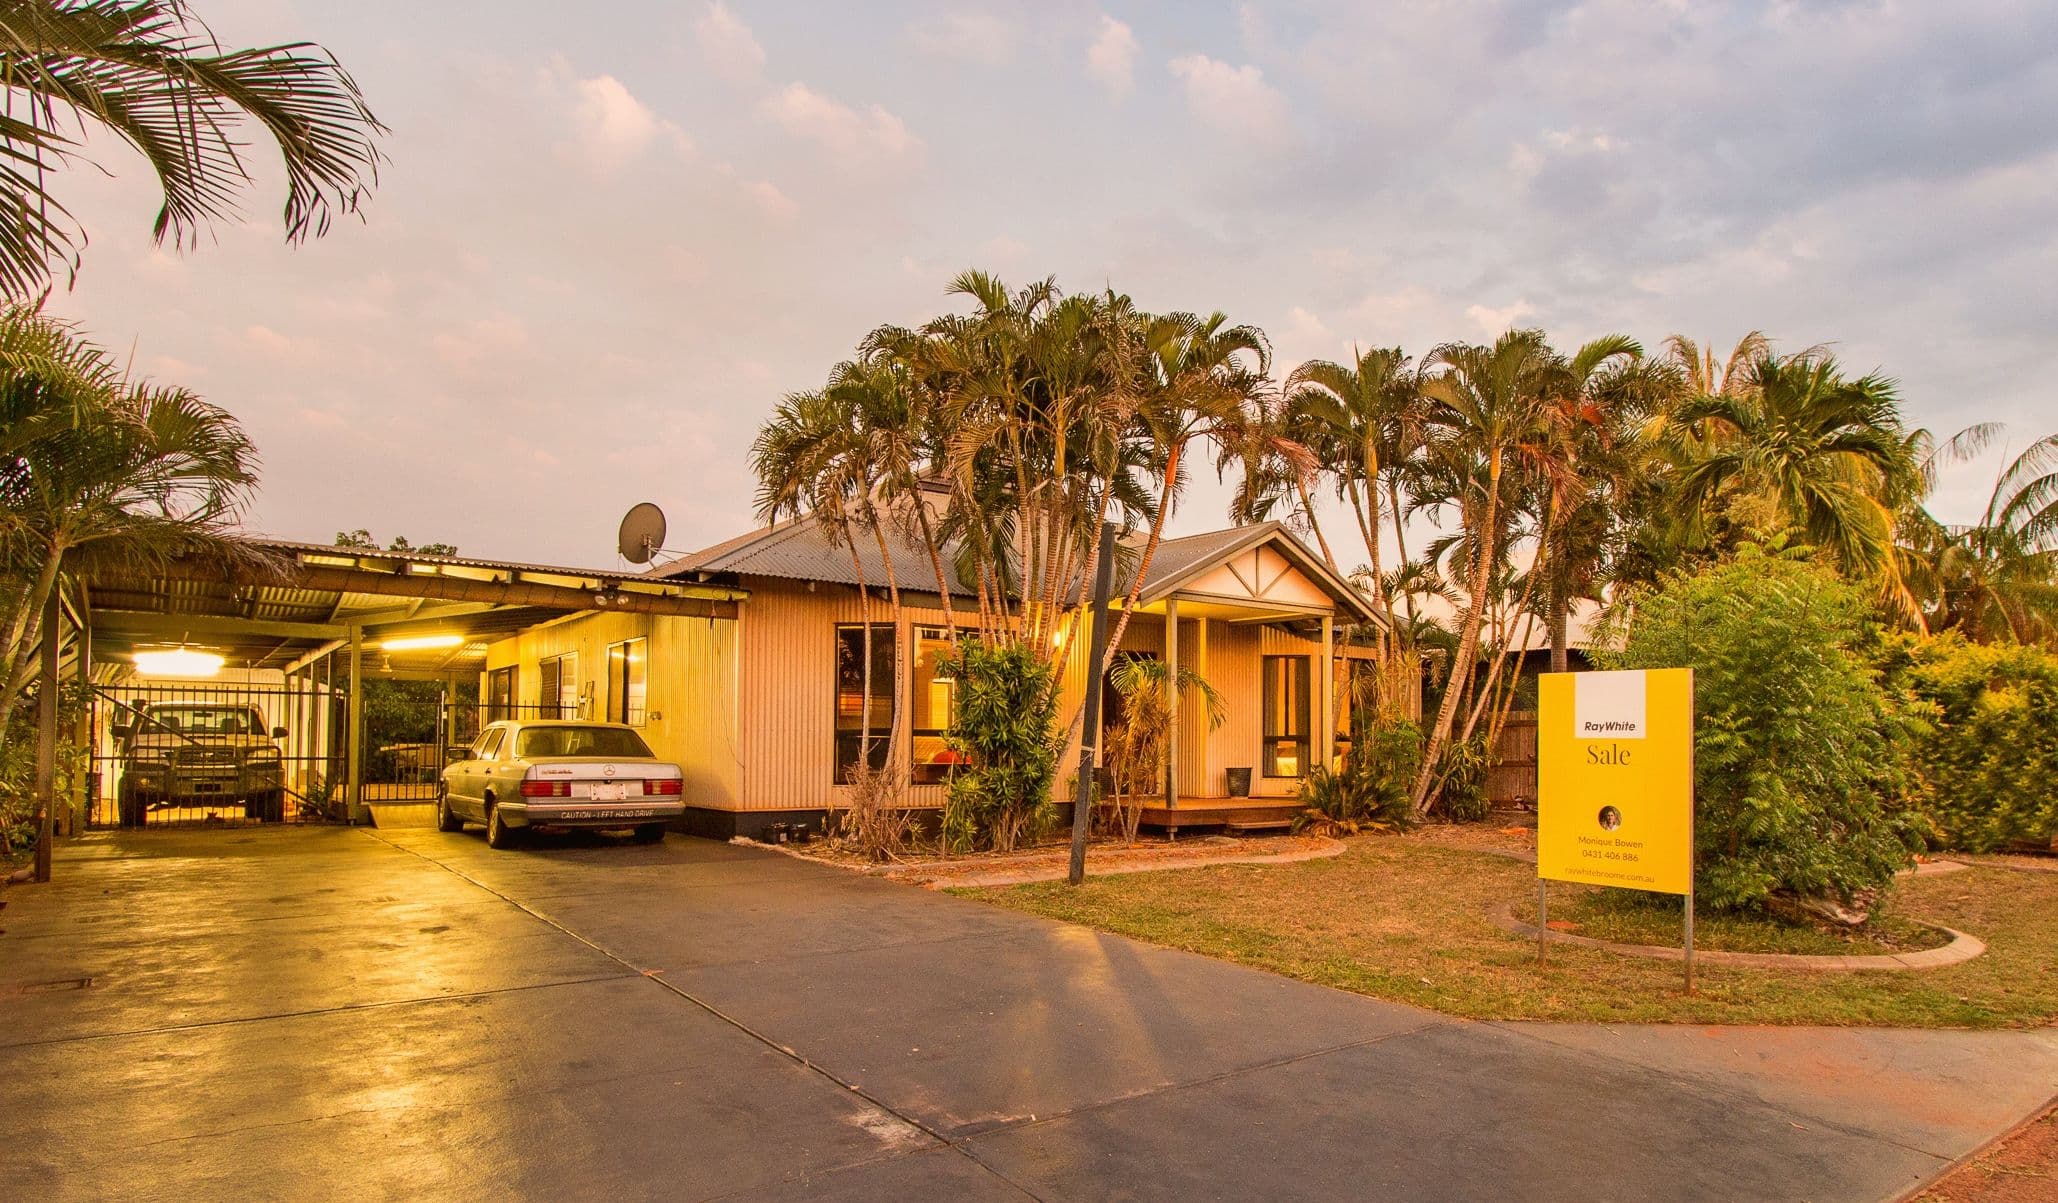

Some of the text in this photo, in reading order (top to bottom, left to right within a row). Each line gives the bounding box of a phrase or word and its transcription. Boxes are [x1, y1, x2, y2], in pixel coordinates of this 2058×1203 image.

[1587, 743, 1631, 766] Sale
[561, 811, 592, 819] CAUTION
[597, 810, 614, 818] LEFT
[615, 809, 634, 817] HAND
[634, 809, 654, 817] DRIVE
[1578, 836, 1643, 849] Monique Bowen
[1582, 849, 1639, 862] 0431 406 886
[1565, 867, 1655, 883] raywhitebroome.com.au
